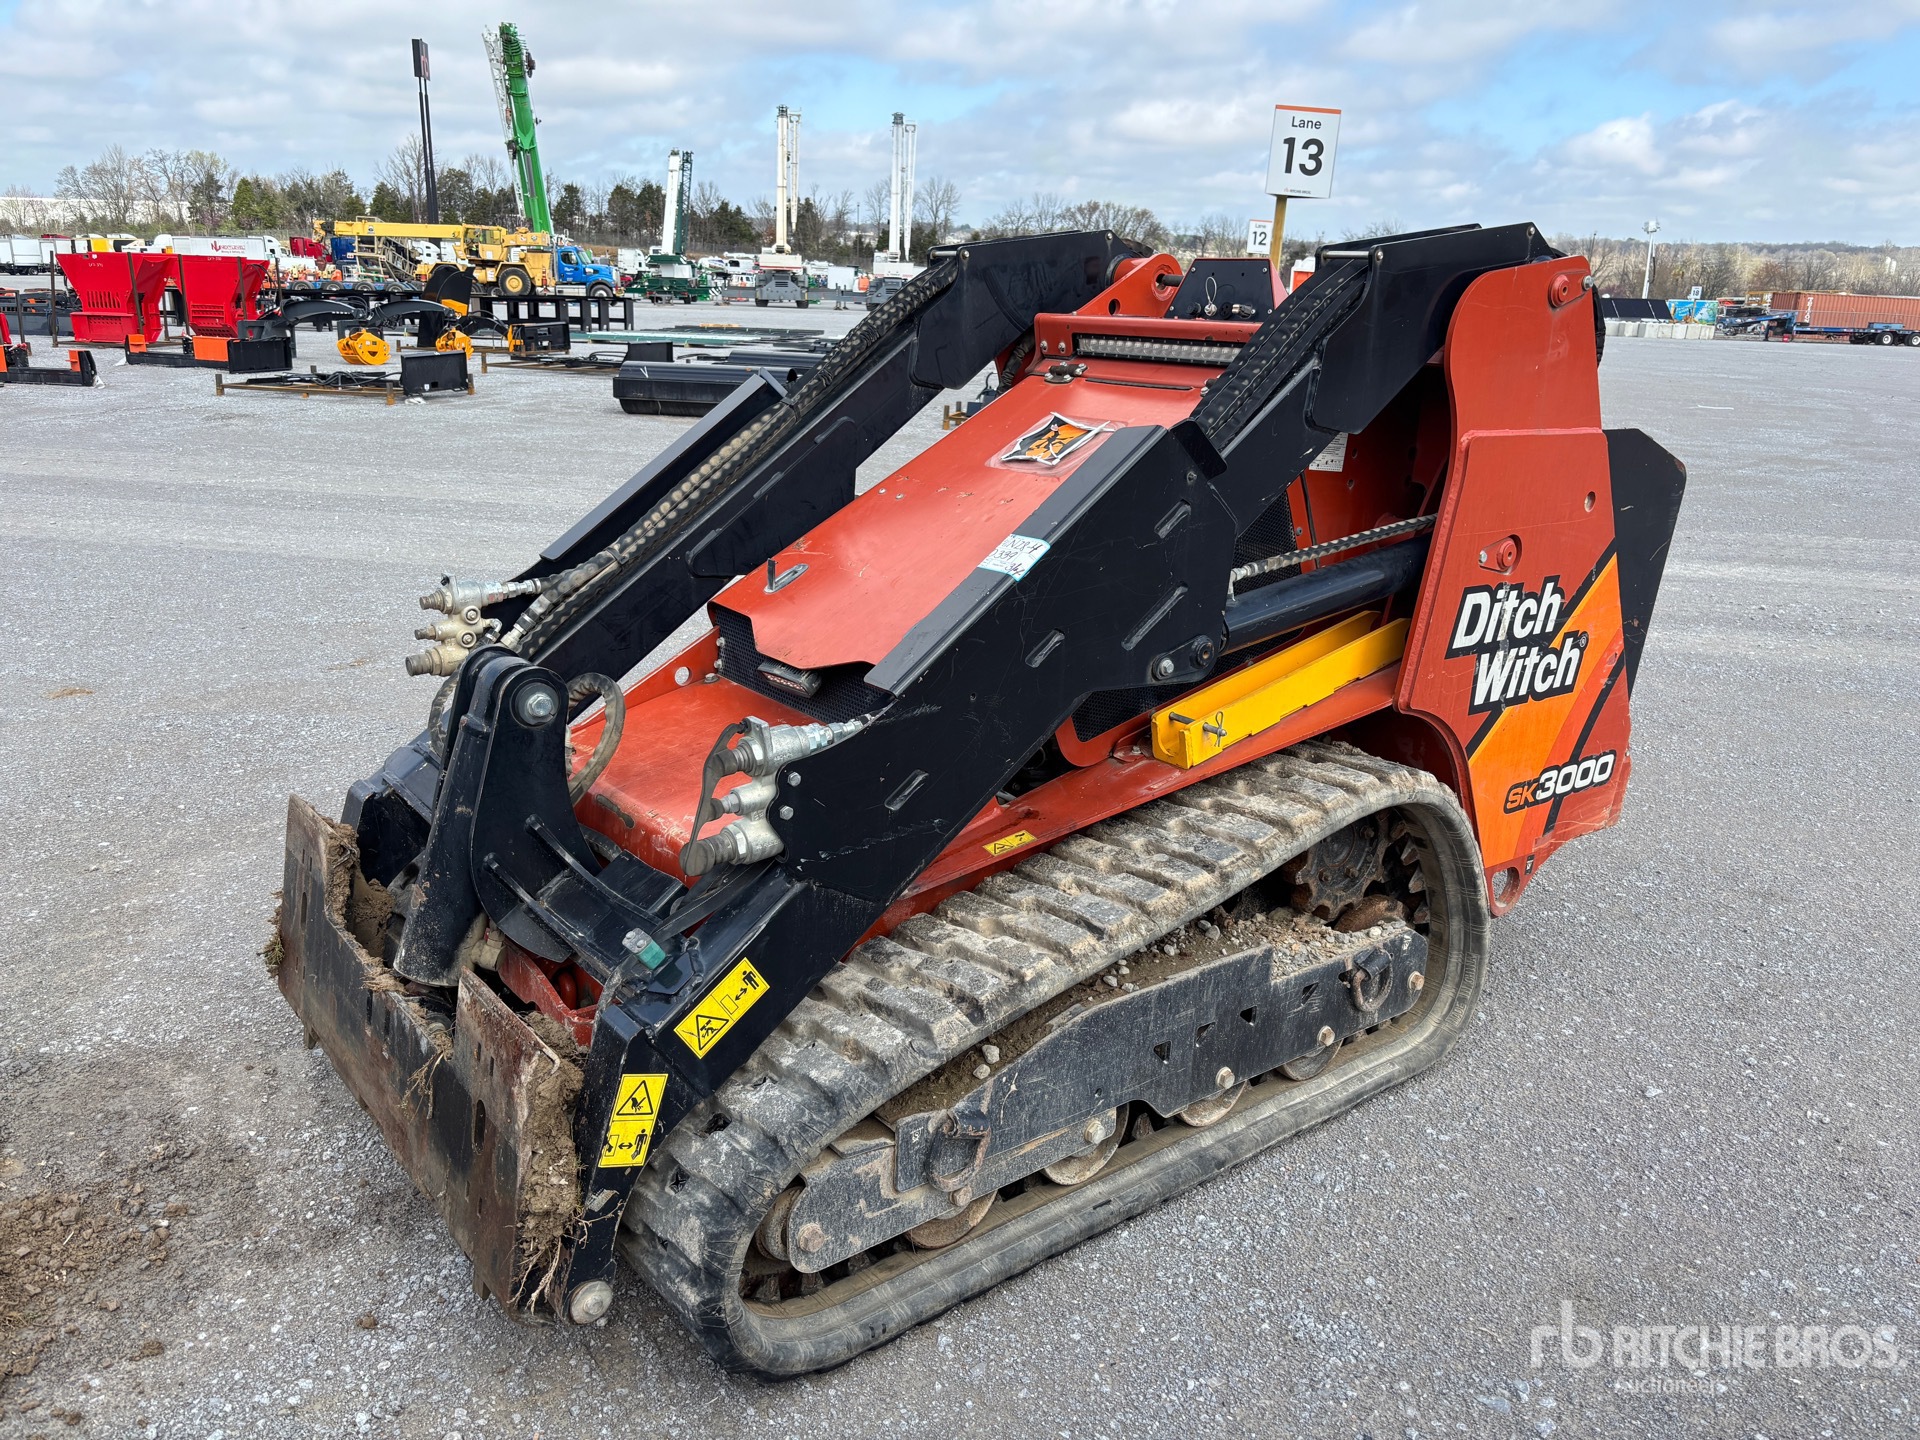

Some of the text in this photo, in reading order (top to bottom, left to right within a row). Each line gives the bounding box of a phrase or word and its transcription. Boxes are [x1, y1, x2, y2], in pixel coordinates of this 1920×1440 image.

[1291, 115, 1322, 130] Lane
[1283, 136, 1324, 176] 13
[1252, 231, 1267, 246] 12
[1452, 582, 1562, 649] Ditch
[1506, 754, 1615, 810] SK3000
